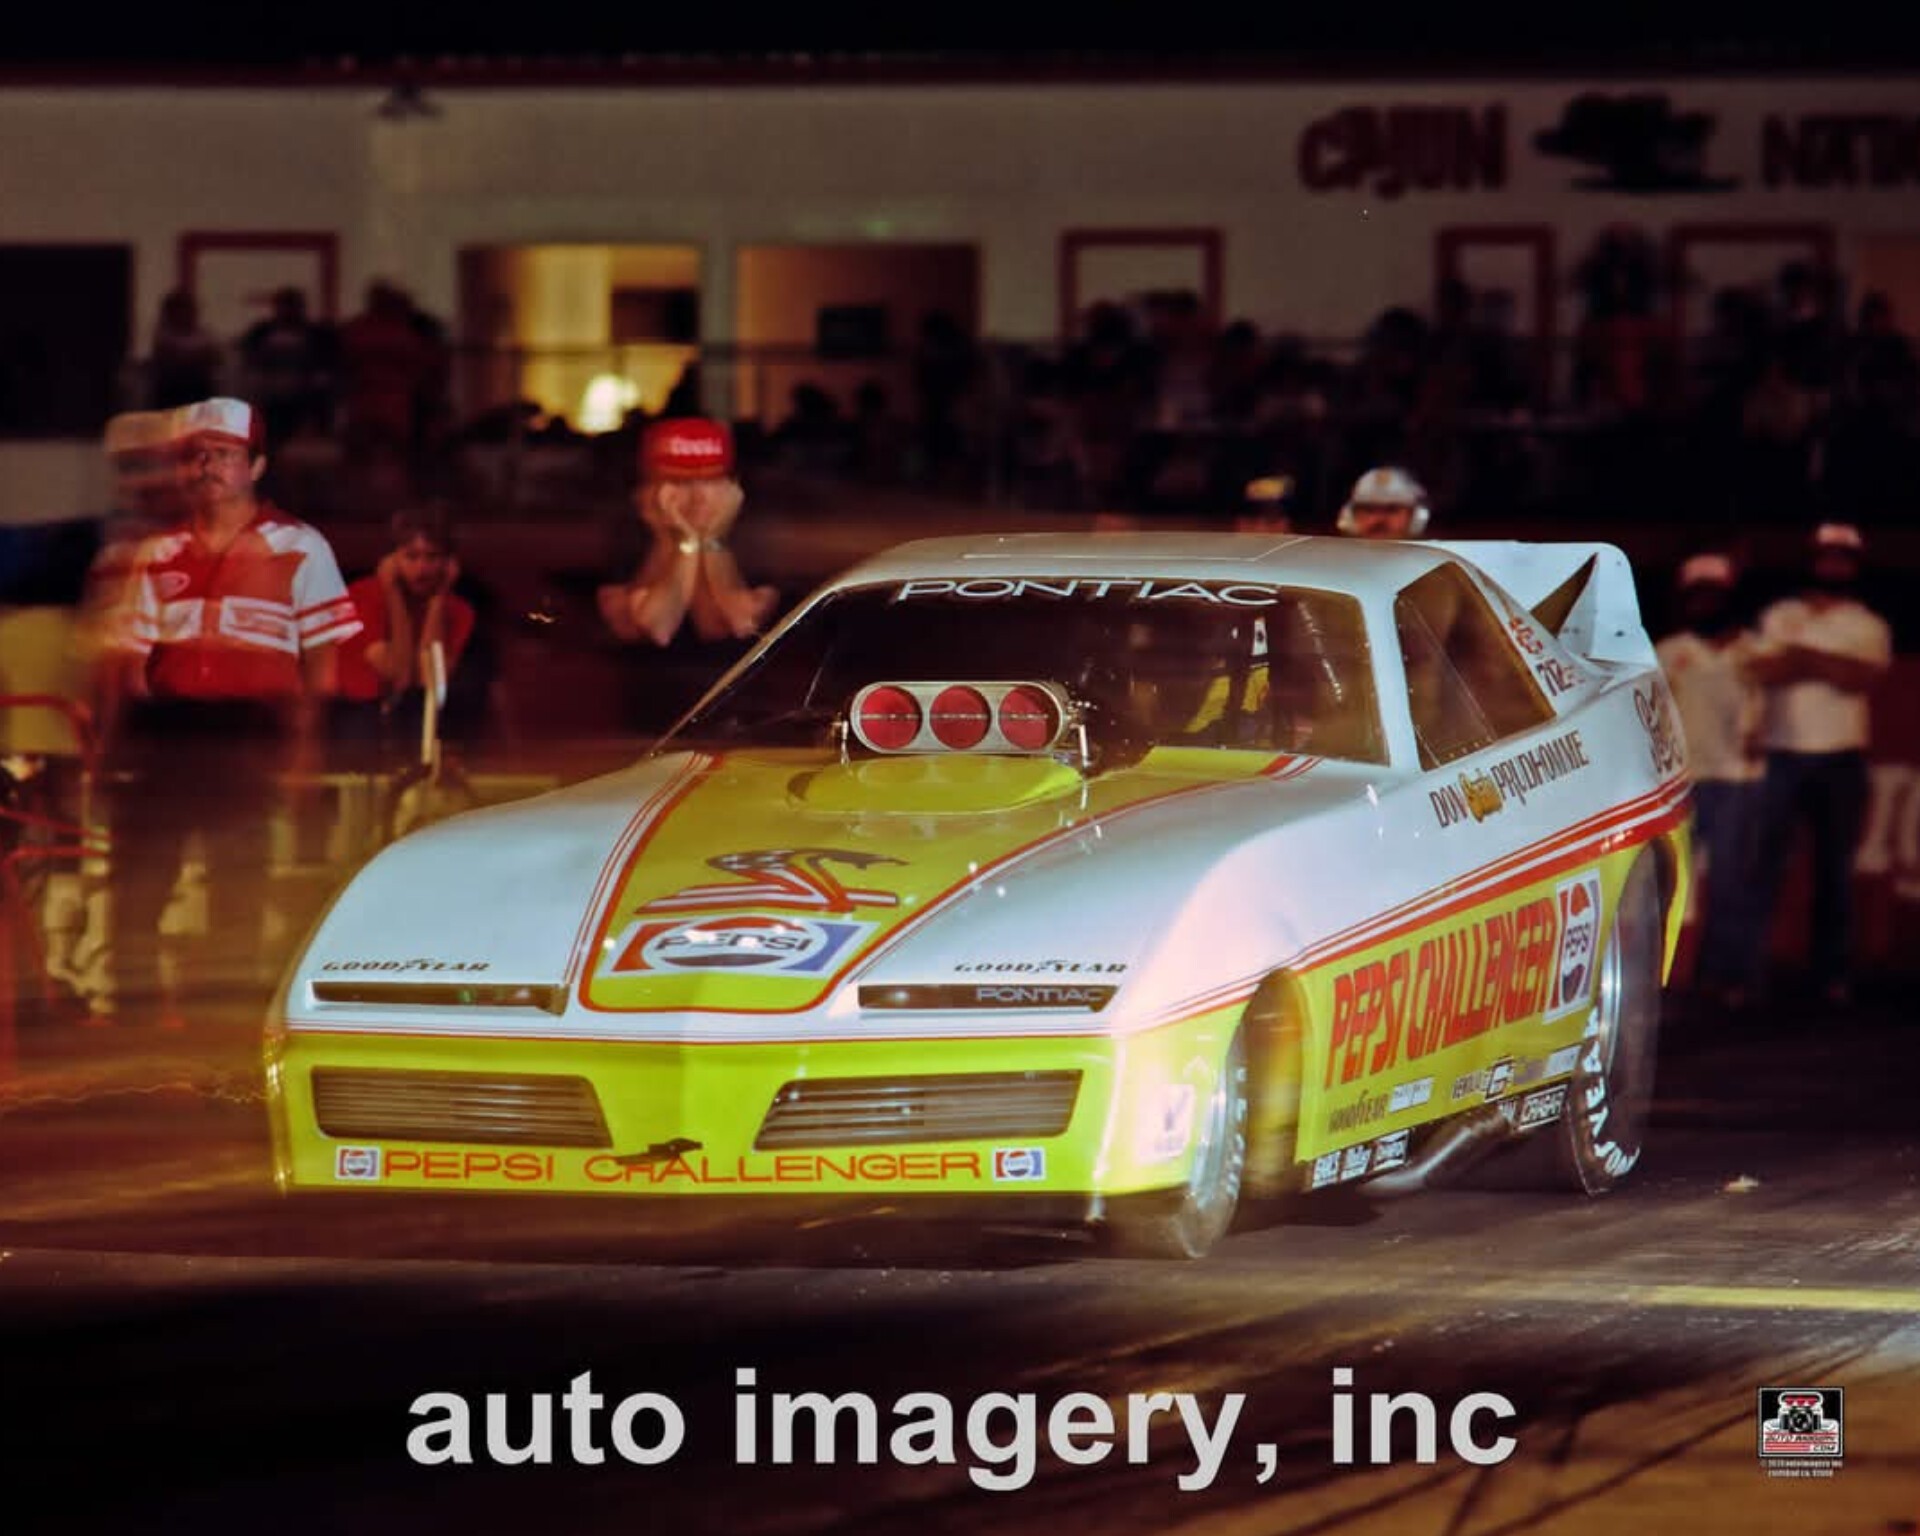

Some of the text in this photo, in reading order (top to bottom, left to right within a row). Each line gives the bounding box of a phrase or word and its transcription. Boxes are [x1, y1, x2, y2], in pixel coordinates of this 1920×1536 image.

[1761, 112, 1920, 188] NATI
[899, 579, 1279, 605] PONTIAC
[1429, 785, 1468, 828] DON
[322, 958, 490, 972] GOODYEAR
[953, 960, 1127, 973] GOODYEAR
[976, 986, 1103, 1002] PONTIAC
[1324, 896, 1558, 1091] PEPSI CHALLENGER
[384, 1151, 982, 1183] PEPSI CHALLENGER
